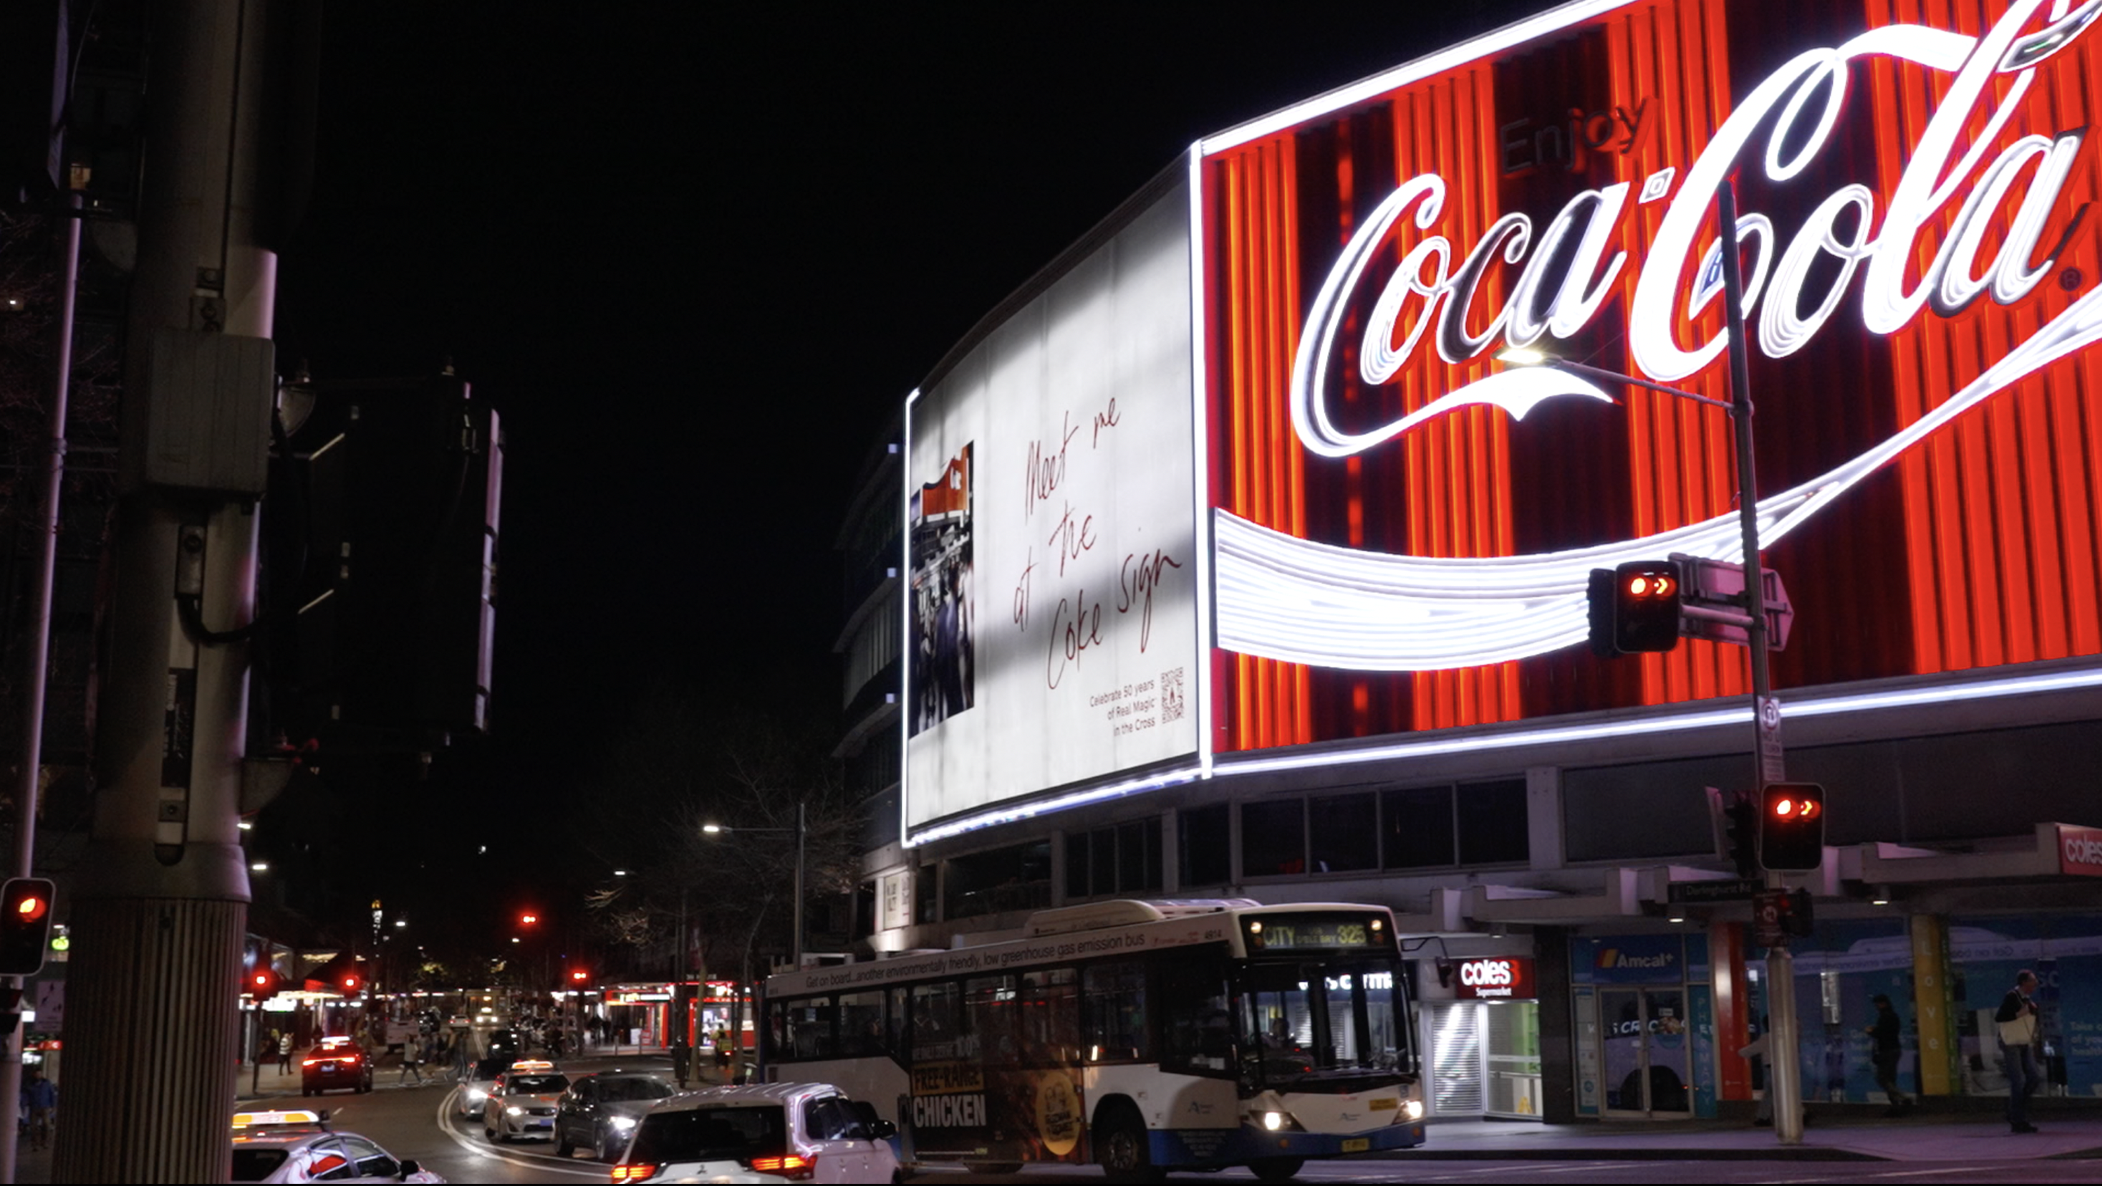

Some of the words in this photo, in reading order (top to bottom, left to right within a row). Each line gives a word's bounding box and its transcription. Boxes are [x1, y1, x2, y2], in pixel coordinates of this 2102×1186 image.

[1501, 98, 1650, 174] Enjoy
[1025, 410, 1079, 526] Meet
[1093, 397, 1121, 449] me
[1013, 545, 1039, 632] at
[1048, 499, 1097, 578] the
[1047, 588, 1103, 690] Coke
[1089, 689, 1122, 707] Celebrate
[1123, 684, 1133, 698] 50
[1134, 680, 1155, 697] years
[1107, 707, 1115, 720] of
[1116, 702, 1132, 718] Real
[1113, 724, 1121, 737] in
[1121, 722, 1133, 735] the
[1134, 717, 1155, 731] Cross
[2065, 832, 2102, 866] coles
[1262, 925, 1296, 946] CITY
[1336, 924, 1367, 944] 325
[805, 973, 819, 989] Get
[819, 976, 830, 988] on
[886, 957, 948, 977] environmentally
[948, 952, 982, 971] friendly,
[983, 950, 1000, 966] low
[1001, 944, 1056, 967] greenhouse
[1057, 942, 1076, 960] gas
[1077, 933, 1123, 954] emission
[1125, 932, 1145, 948] bus
[1460, 959, 1512, 986] coles
[1475, 986, 1513, 999] Supermarket
[1697, 997, 1712, 1105] PHRMACY
[914, 1064, 981, 1092] FREE-RANGE
[912, 1094, 987, 1129] CHICKEN
